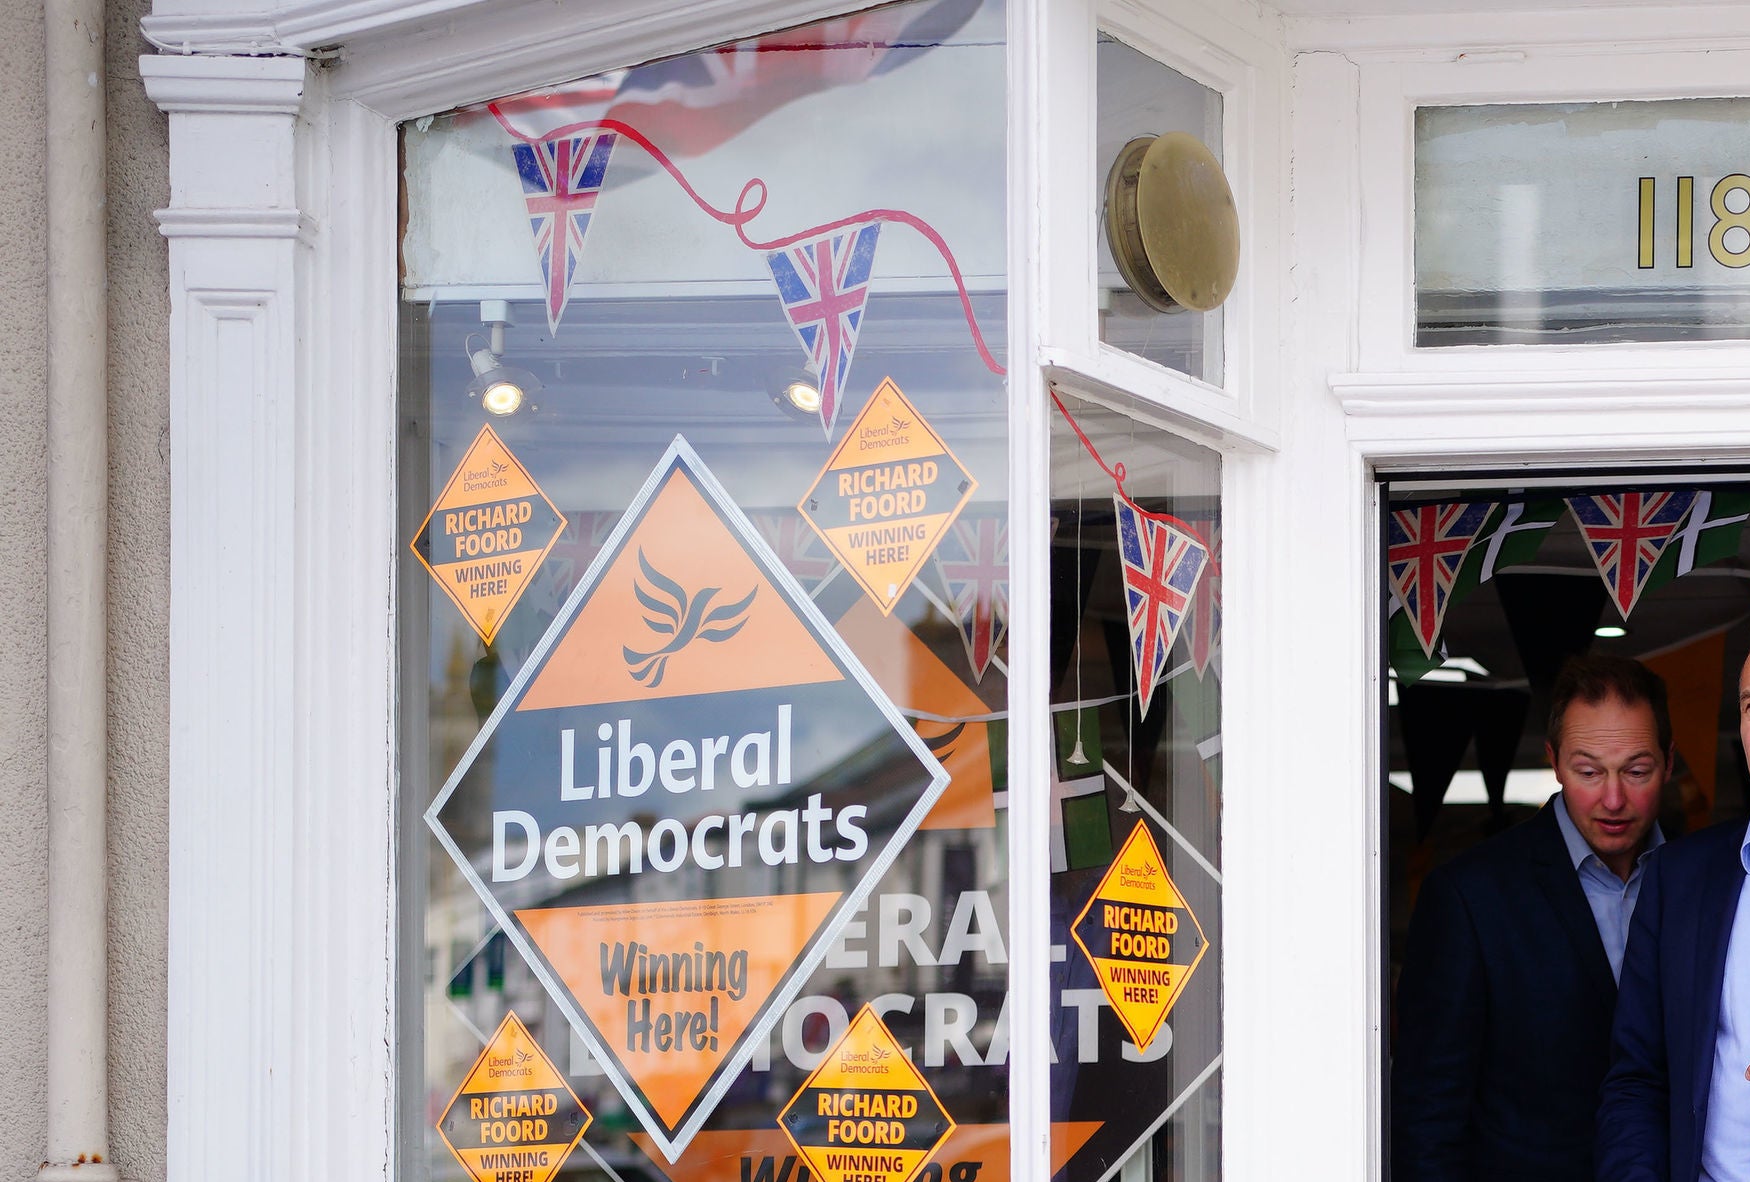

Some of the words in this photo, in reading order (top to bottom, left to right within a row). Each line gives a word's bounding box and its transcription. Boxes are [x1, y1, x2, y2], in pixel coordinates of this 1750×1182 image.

[859, 424, 889, 439] Liberal
[859, 434, 910, 451] Democrats
[463, 467, 490, 482] Liberal
[463, 477, 508, 493] Democrats
[838, 461, 938, 497] RICHARD
[849, 489, 926, 522] FOORD
[445, 501, 532, 535] RICHARD
[454, 527, 523, 558] FOORD
[848, 523, 926, 550] WINNING
[865, 544, 909, 567] HERE!
[454, 558, 522, 584] WINNING
[469, 578, 508, 599] HERE!
[560, 704, 792, 802] Liberal
[491, 792, 869, 883] Democrats
[1120, 864, 1143, 878] Liberal
[1120, 875, 1156, 891] Democrats
[1103, 904, 1179, 934] RICHARD
[1110, 931, 1171, 960] FOORD
[600, 941, 748, 1001] Winning
[1110, 966, 1171, 988] WINNING
[1123, 986, 1159, 1005] HERE!
[626, 996, 719, 1053] Here!
[488, 1056, 513, 1068] Liberal
[840, 1050, 869, 1063] Liberal
[840, 1061, 889, 1075] Democrats
[488, 1066, 533, 1079] Democrats
[469, 1094, 557, 1120] RICHARD
[817, 1093, 918, 1119] RICHARD
[480, 1119, 548, 1144] FOORD
[827, 1118, 906, 1145] FOORD
[480, 1151, 548, 1170] WINNING
[826, 1153, 904, 1173] WINNING
